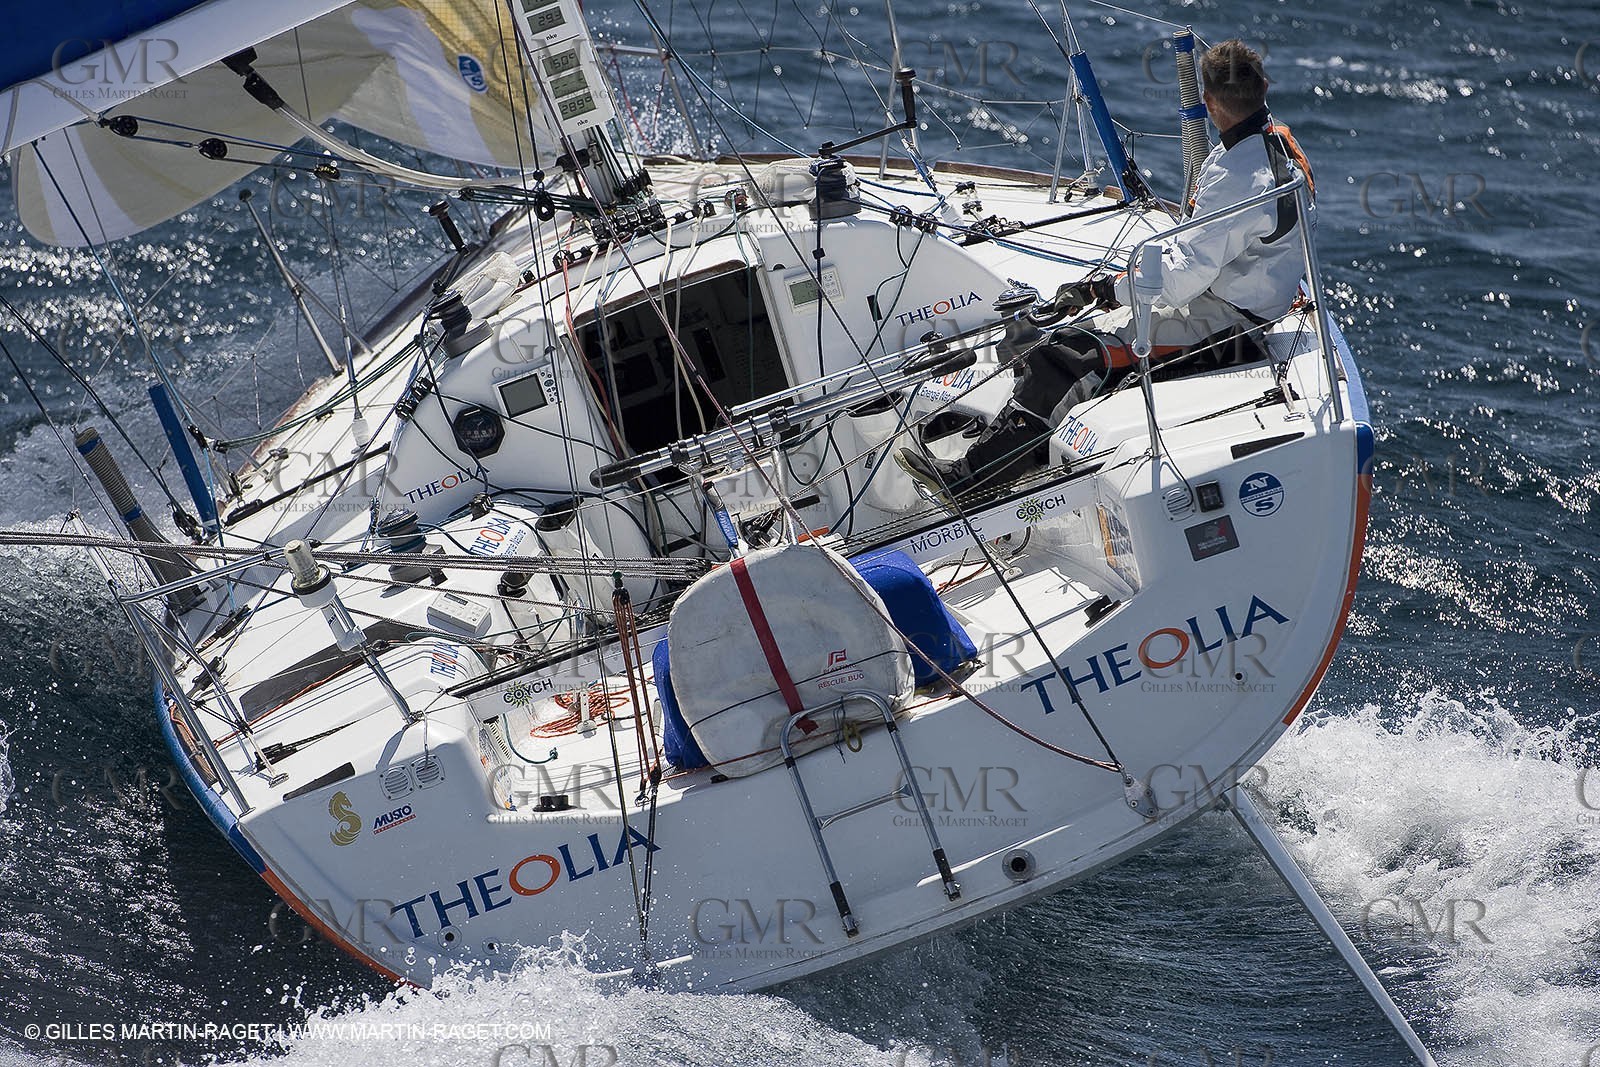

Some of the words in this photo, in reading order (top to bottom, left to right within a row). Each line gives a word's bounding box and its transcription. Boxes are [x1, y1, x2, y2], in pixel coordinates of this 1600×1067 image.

[894, 291, 982, 327] THEOLIA
[1059, 415, 1100, 456] THEOLIA
[404, 467, 490, 504] THEOLIA
[1246, 475, 1269, 492] N
[1256, 497, 1274, 512] S
[469, 517, 511, 556] THEOLIA
[431, 641, 459, 679] THEOLIA
[1021, 595, 1290, 715] THEOLIA
[373, 804, 413, 830] MUSTO
[391, 824, 662, 939] THEOLIA
